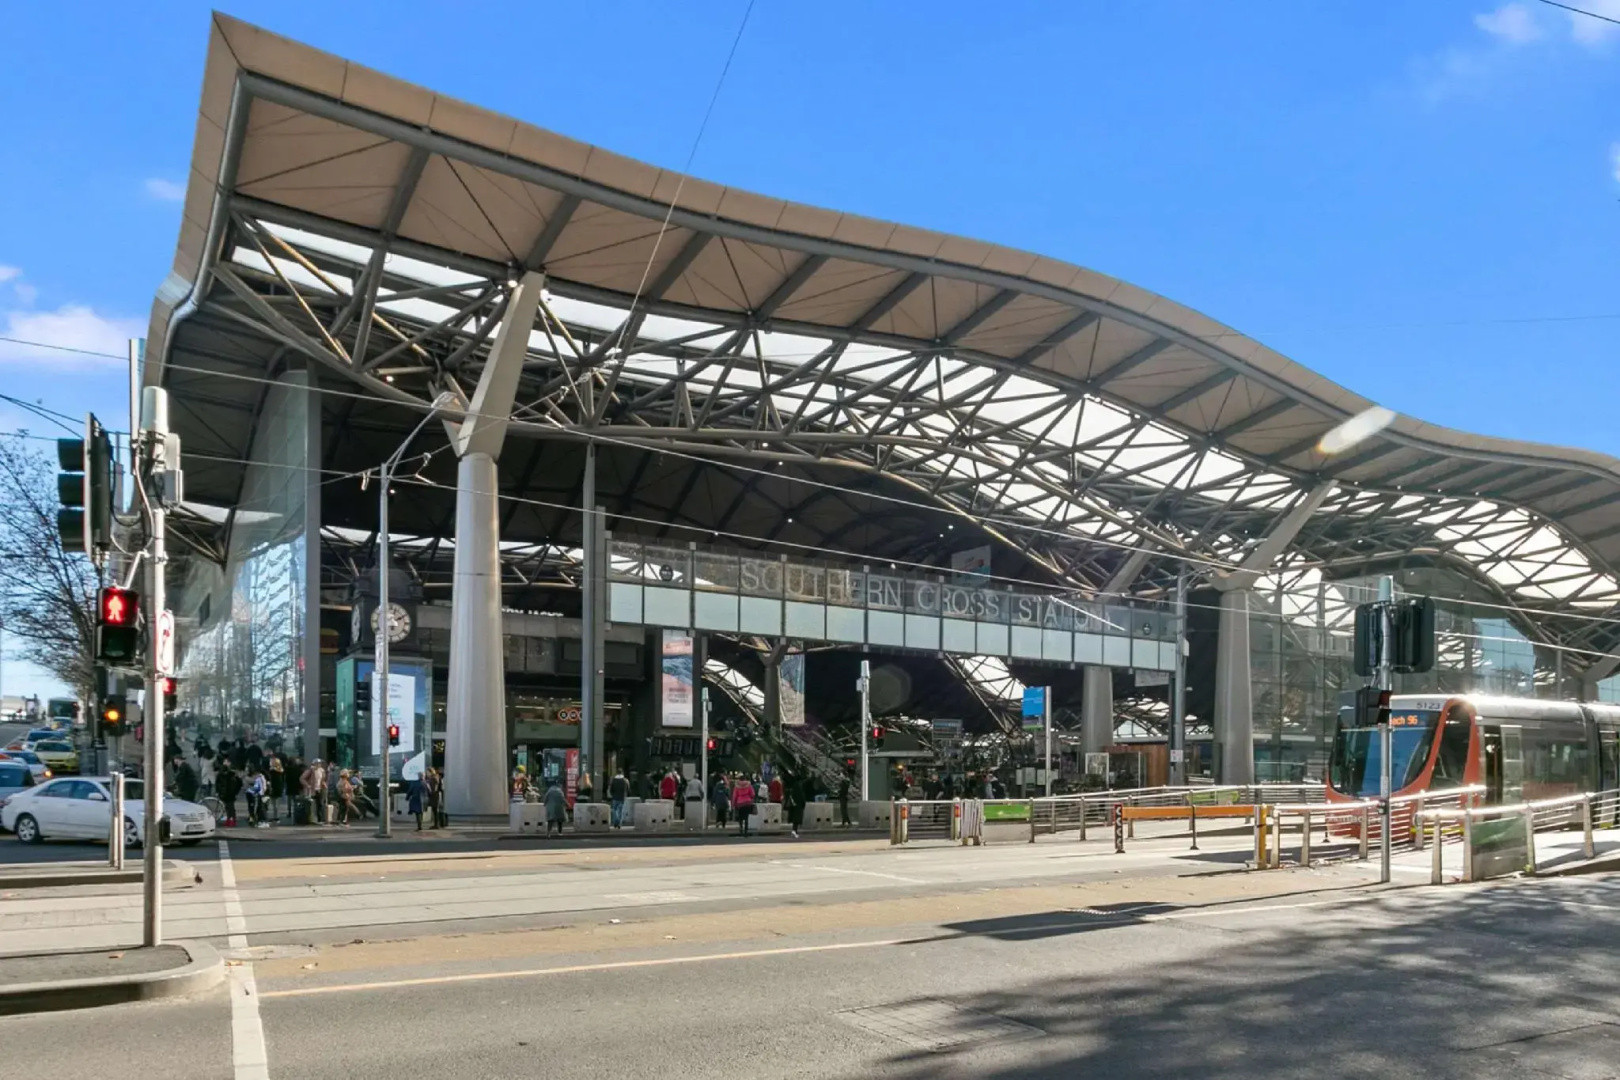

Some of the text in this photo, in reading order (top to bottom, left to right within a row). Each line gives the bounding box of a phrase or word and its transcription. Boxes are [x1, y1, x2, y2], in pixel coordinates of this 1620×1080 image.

[740, 562, 901, 608] SOUTHERN
[917, 585, 1000, 617] CROSS
[1416, 701, 1441, 709] 5123
[1407, 714, 1418, 725] 96
